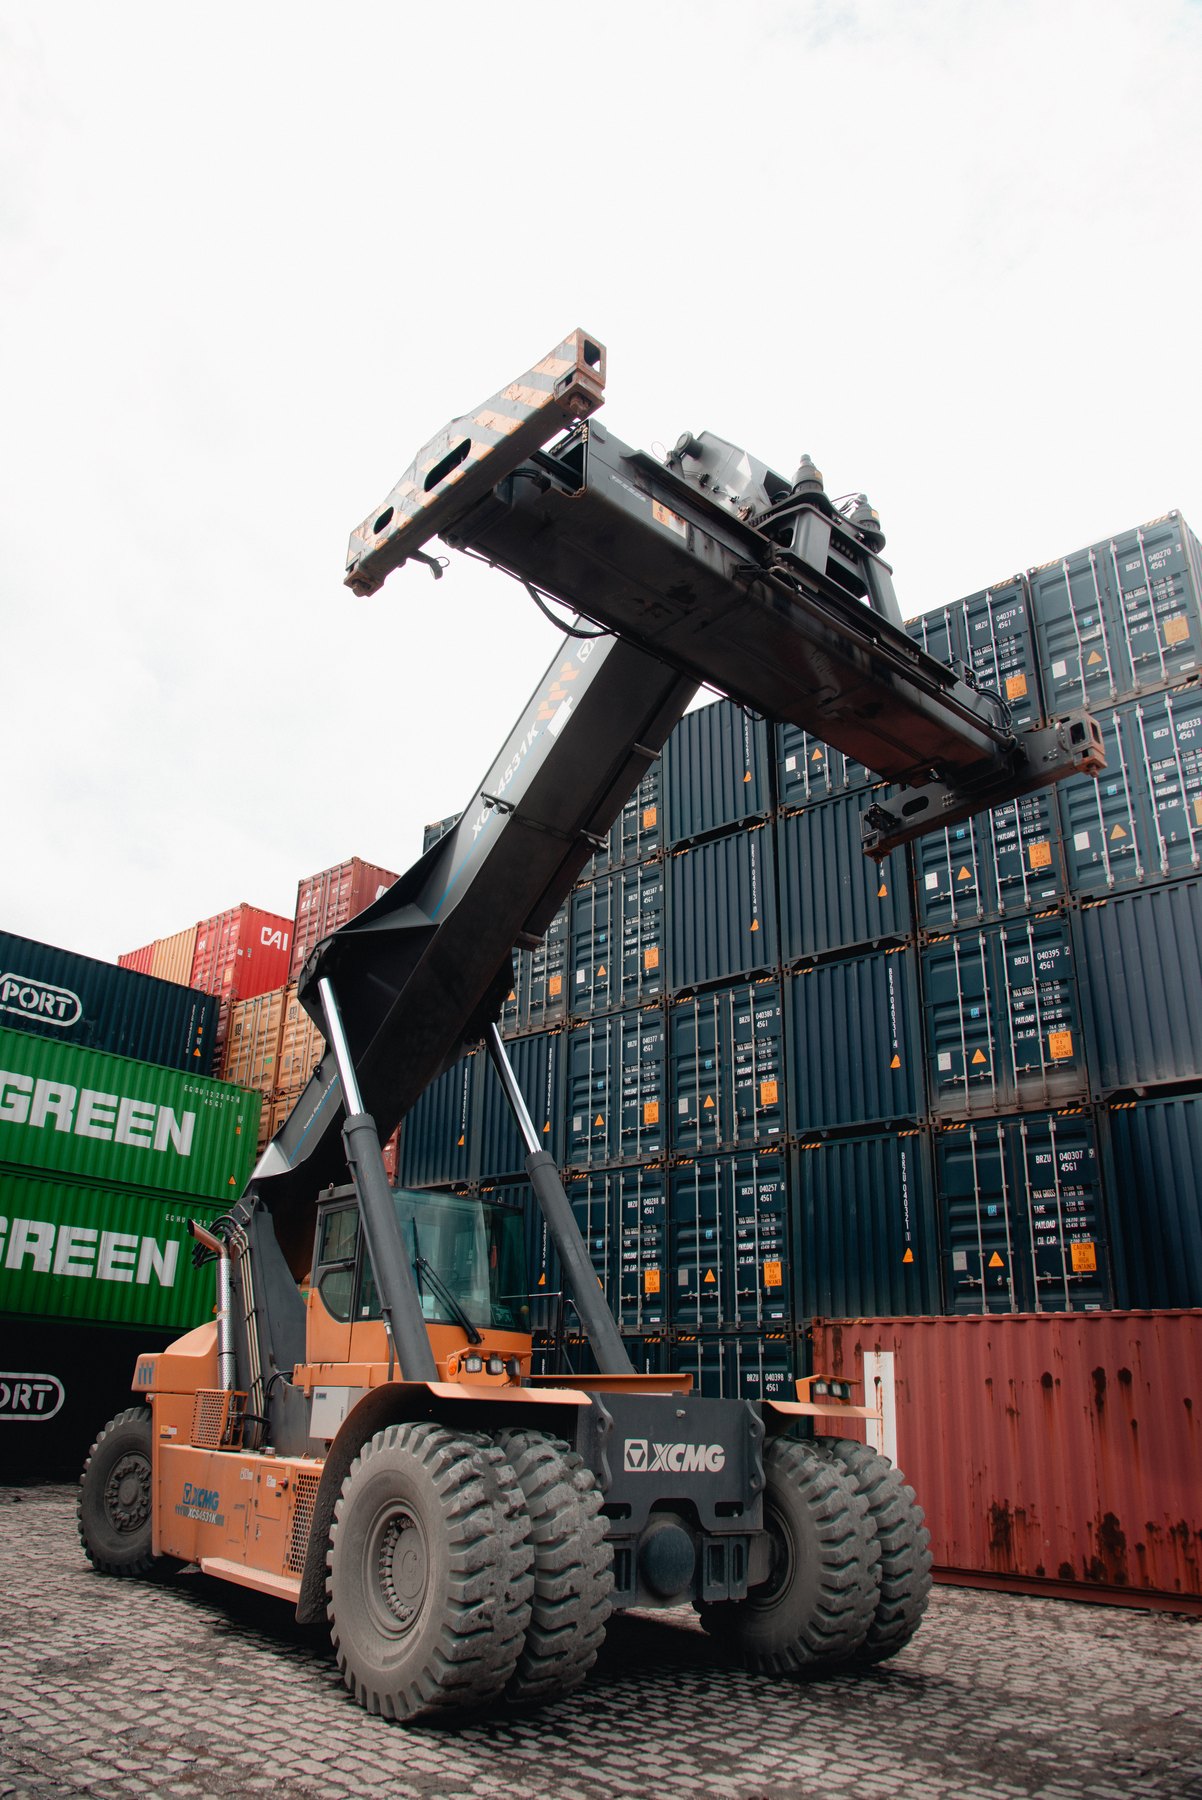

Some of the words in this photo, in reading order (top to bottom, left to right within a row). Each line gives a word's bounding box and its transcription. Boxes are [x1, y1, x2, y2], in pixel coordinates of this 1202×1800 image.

[974, 620, 988, 631] BRZU
[1152, 727, 1169, 740] BRZU
[260, 926, 289, 952] CAI
[1014, 955, 1030, 966] BRZU
[1036, 949, 1060, 961] 040395
[1039, 960, 1055, 971] 45G1
[738, 1015, 751, 1025] BRZU
[0, 1070, 196, 1157] GREEN
[1035, 1154, 1052, 1164] BRZU
[1059, 1150, 1084, 1162] 040307
[1061, 1162, 1077, 1172] 45G1
[741, 1187, 754, 1196] BRZU
[0, 1216, 180, 1288] REEN
[647, 1443, 726, 1473] XCMG
[191, 1487, 219, 1512] XCMG
